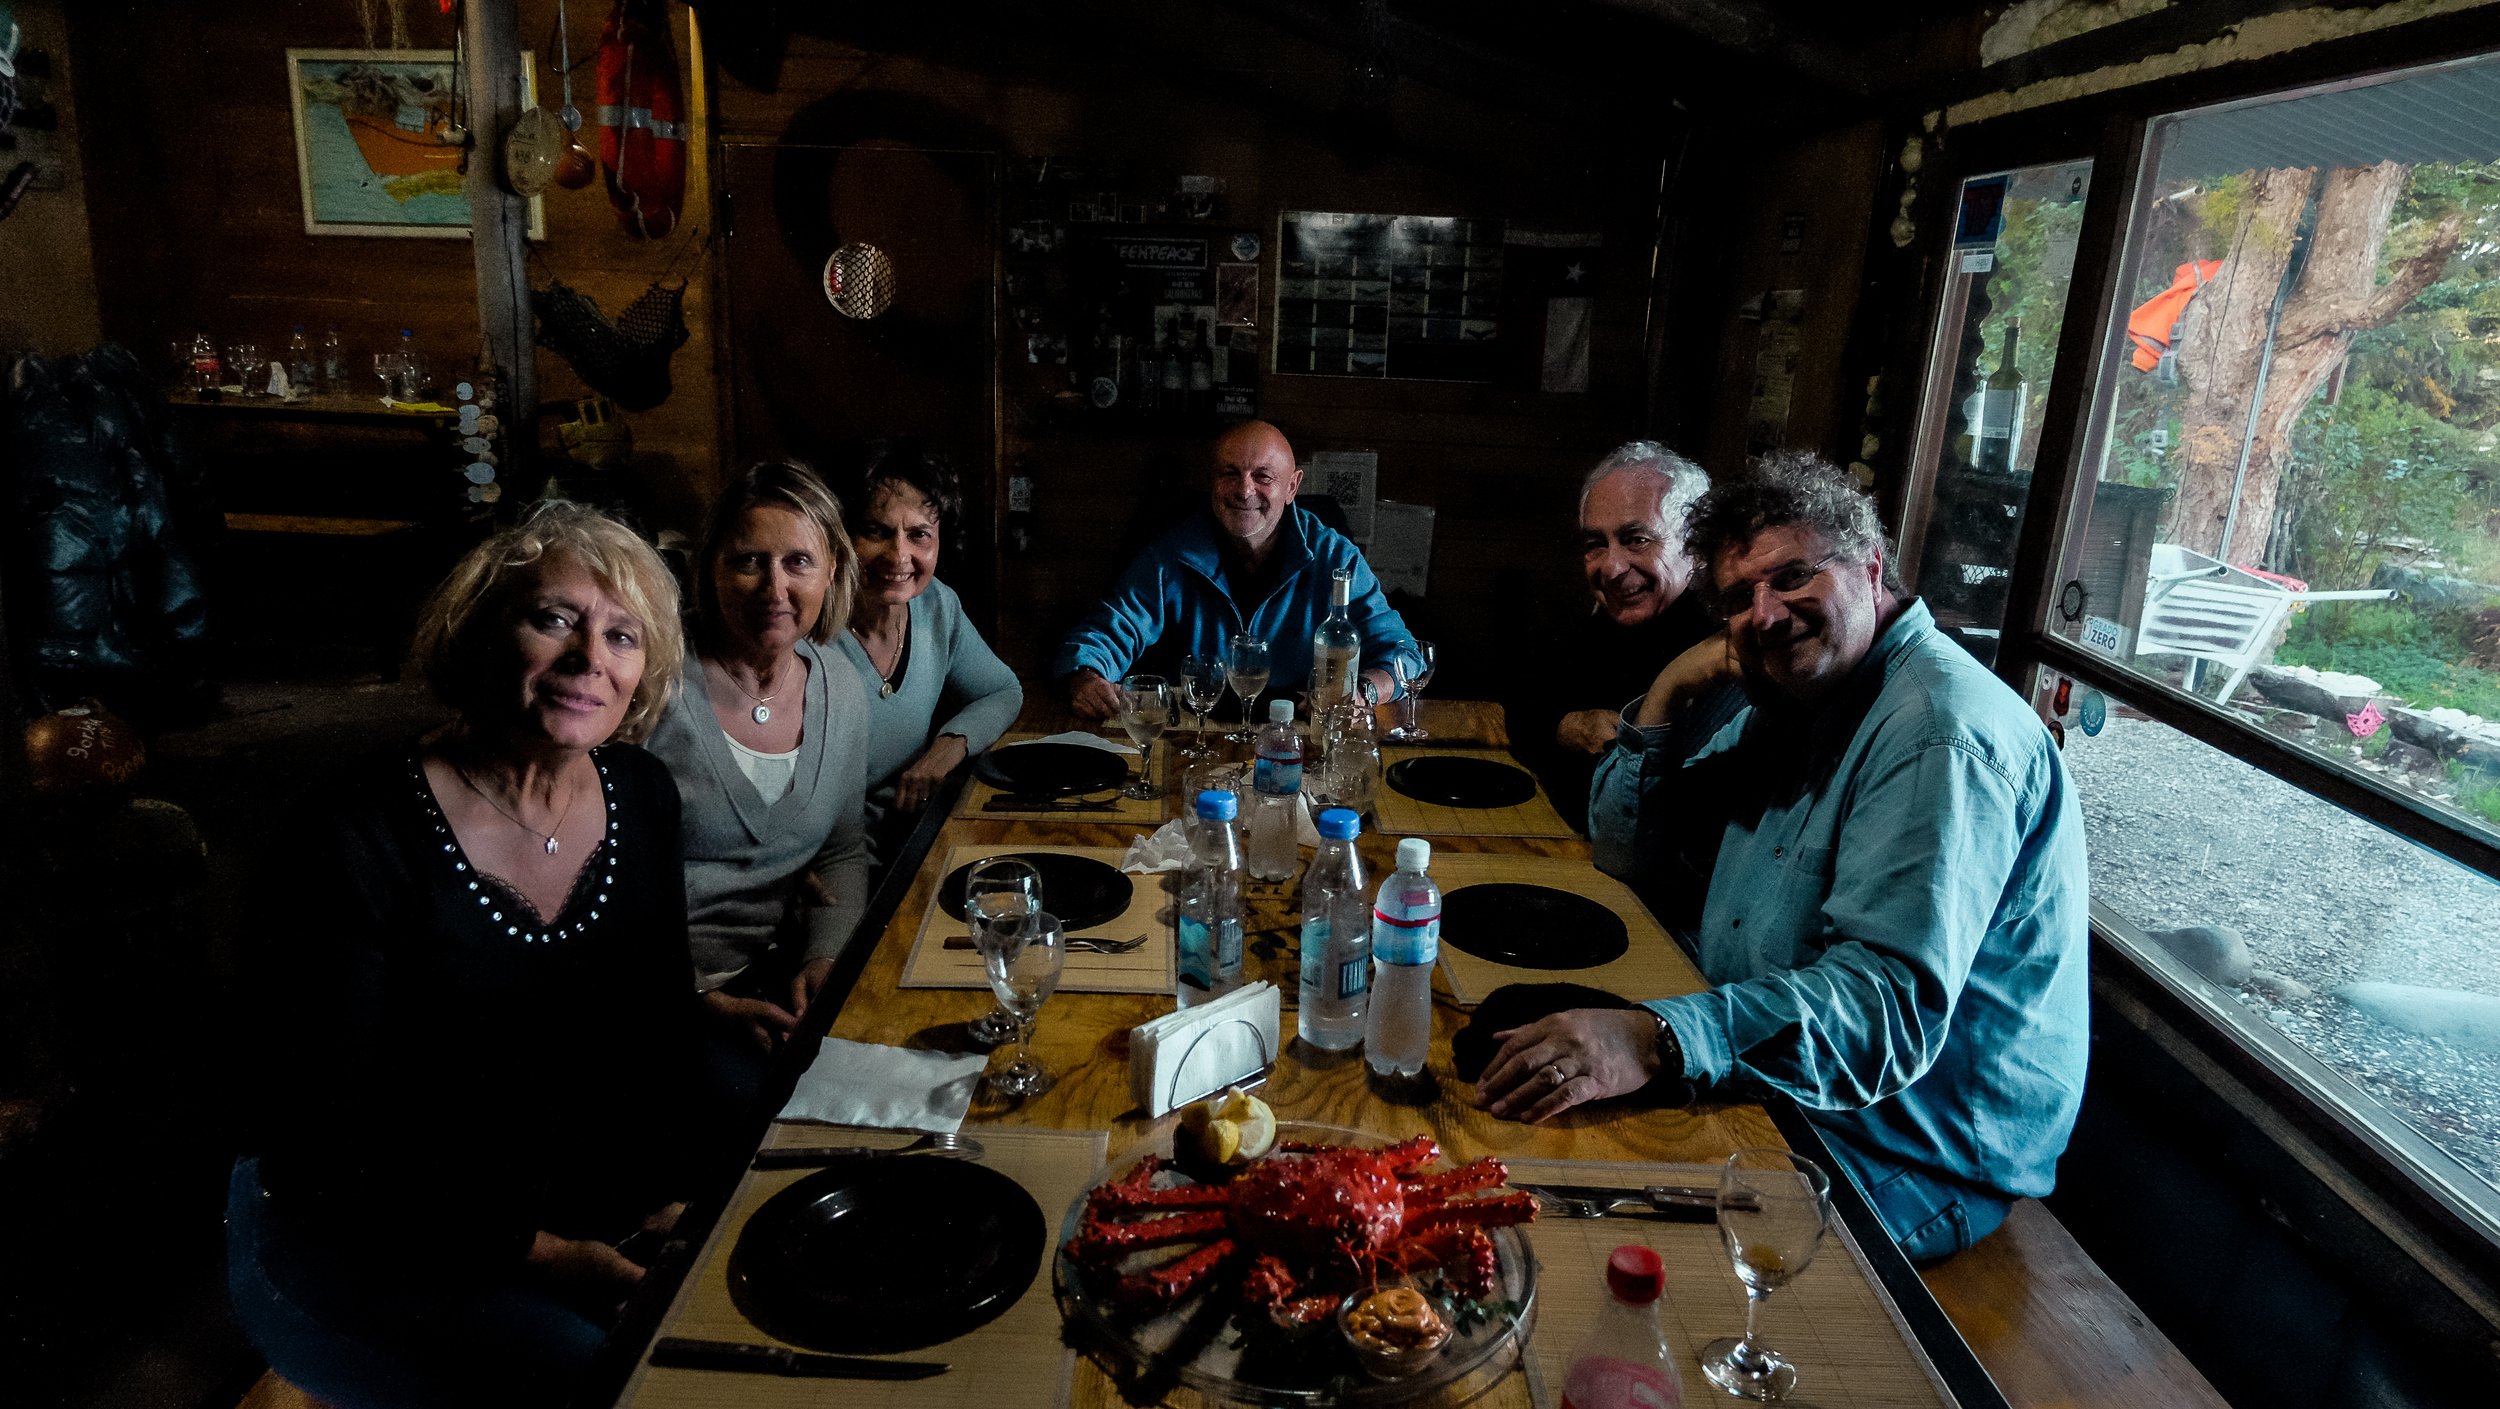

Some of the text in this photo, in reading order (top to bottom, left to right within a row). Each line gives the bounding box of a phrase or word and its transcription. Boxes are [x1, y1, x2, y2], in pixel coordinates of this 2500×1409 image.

[1112, 244, 1201, 261] EENPEACE
[2093, 620, 2118, 637] GRADO
[2090, 629, 2116, 650] ZERO
